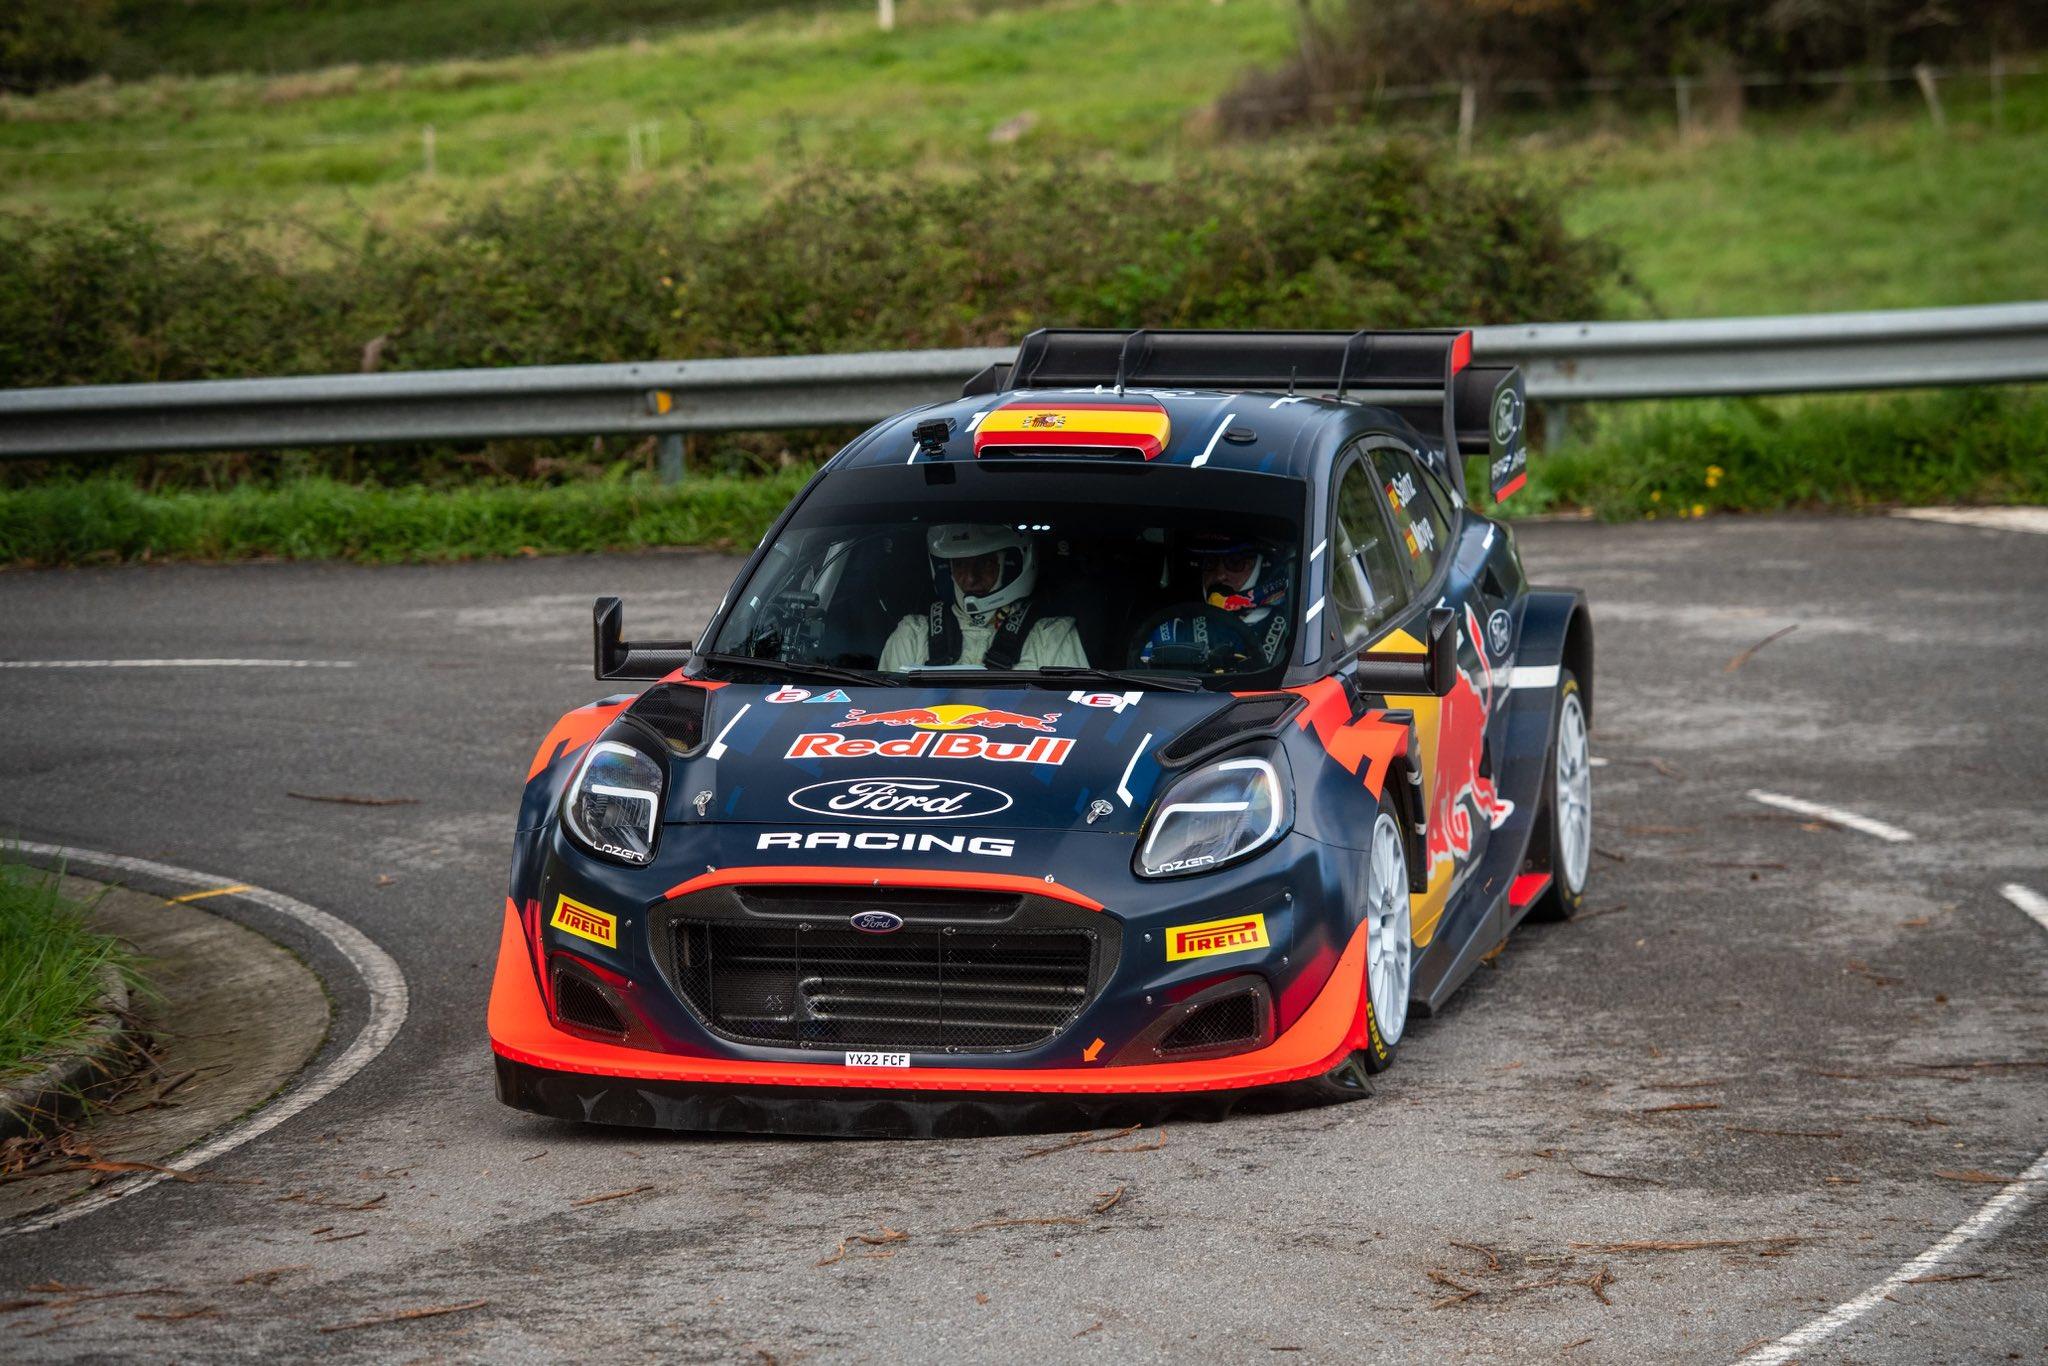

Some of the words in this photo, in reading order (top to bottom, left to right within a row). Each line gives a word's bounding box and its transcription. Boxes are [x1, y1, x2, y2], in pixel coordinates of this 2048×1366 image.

[1392, 471, 1417, 508] Sainz
[1409, 517, 1435, 552] Moya
[785, 732, 936, 760] Red
[929, 734, 1077, 766] Bull
[828, 781, 972, 815] Ford
[756, 832, 1016, 857] RACING
[557, 902, 611, 940] PIRELLI
[861, 914, 891, 928] Ford
[1176, 921, 1258, 954] PIRELLI
[849, 1053, 879, 1066] YX22
[883, 1054, 906, 1067] FCF
